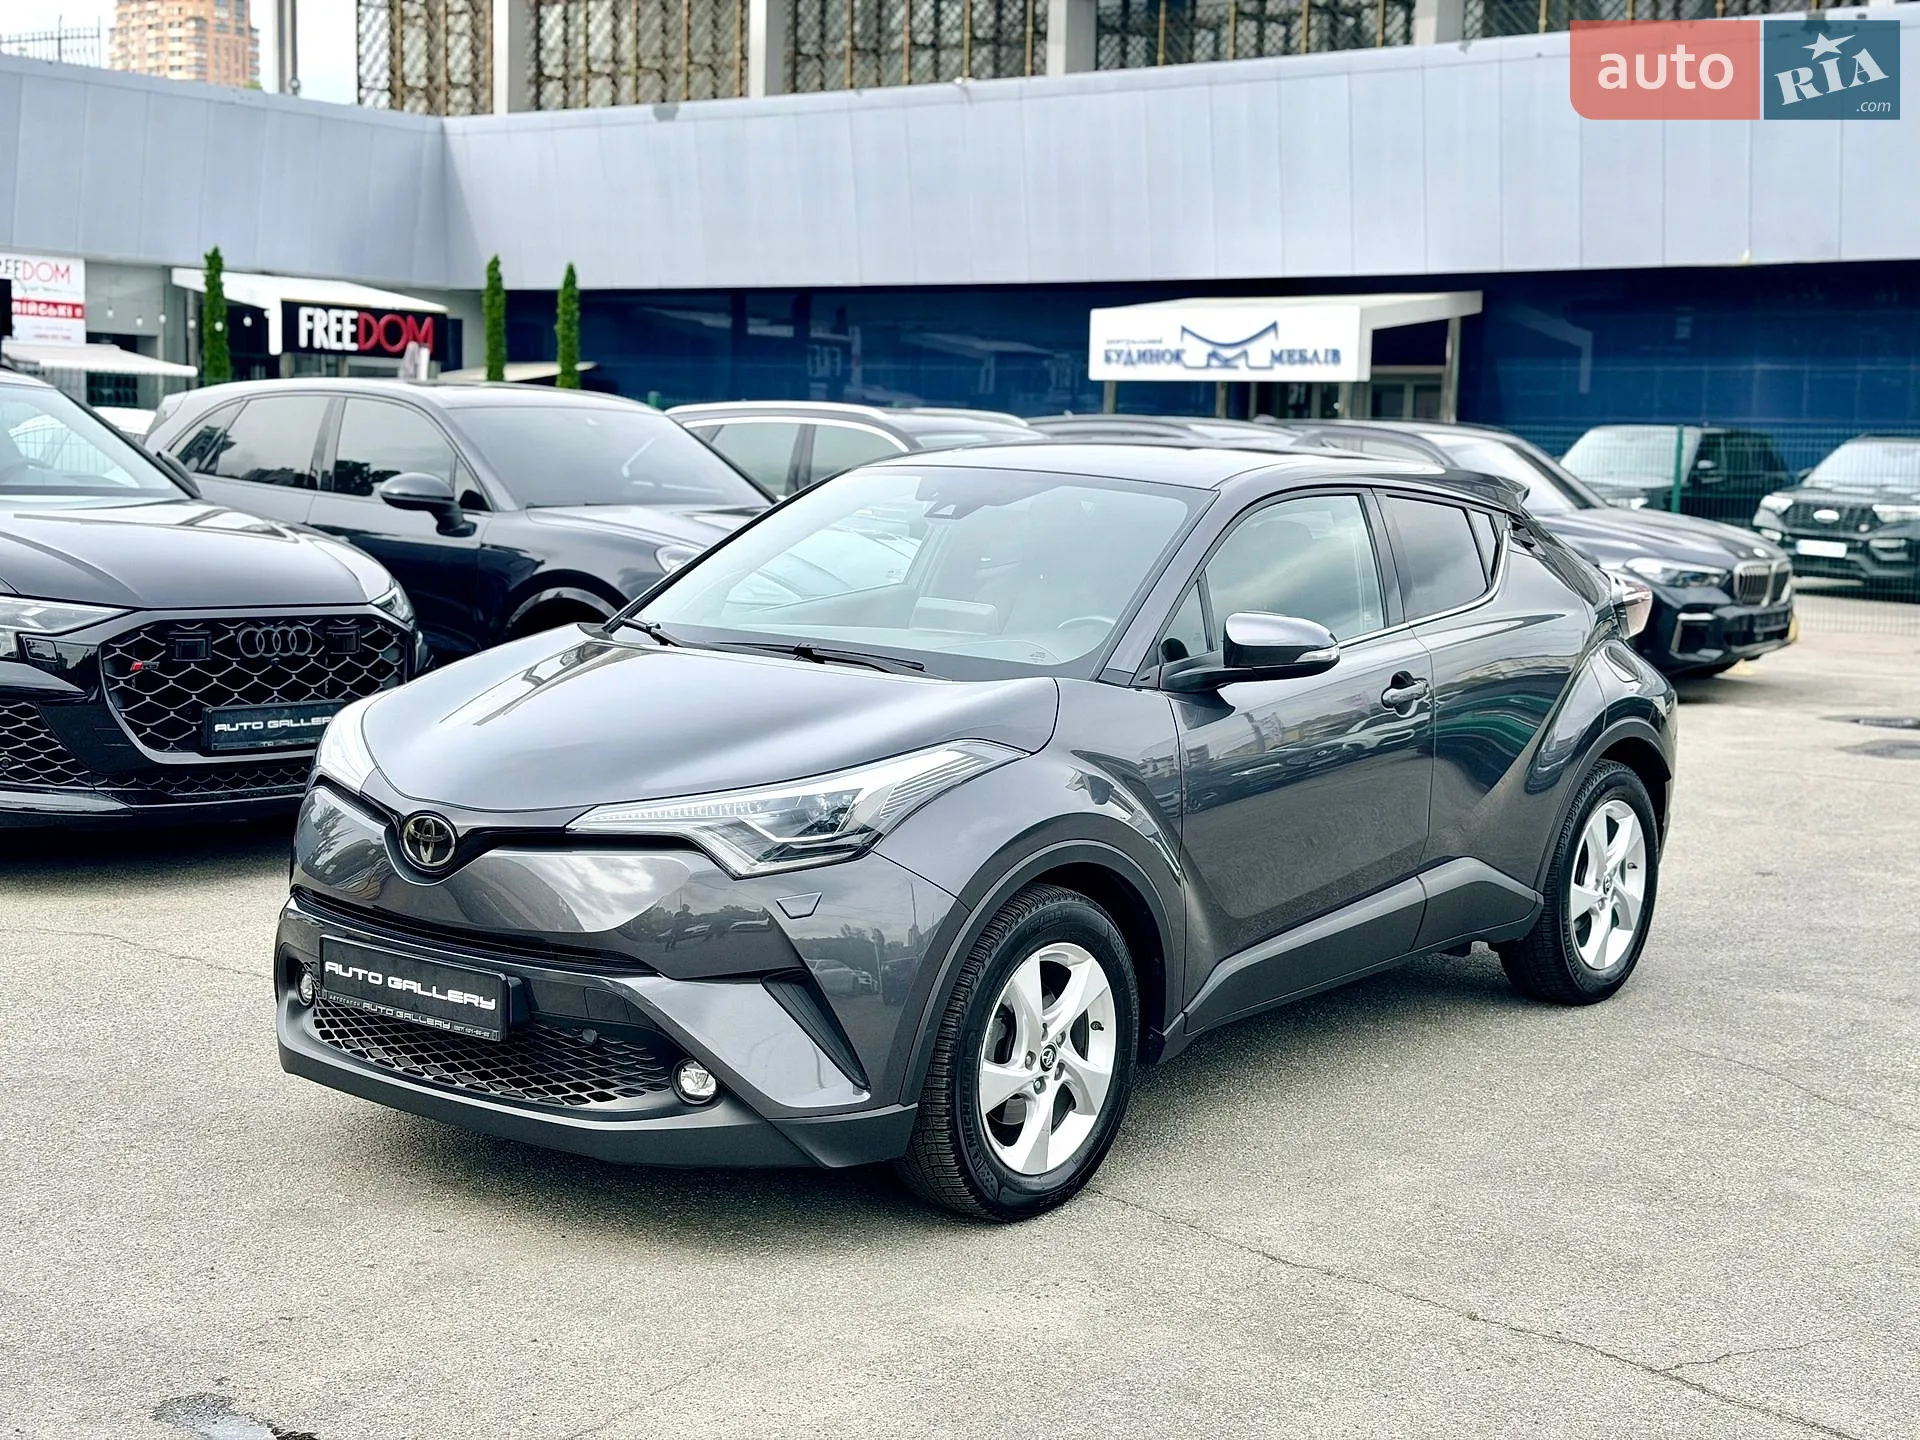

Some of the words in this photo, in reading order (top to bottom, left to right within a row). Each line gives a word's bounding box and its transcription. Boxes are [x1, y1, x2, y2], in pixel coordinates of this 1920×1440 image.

[0, 258, 72, 285] EEDOM
[298, 306, 434, 354] FREEDOM
[214, 721, 264, 733] AUTO
[267, 716, 333, 729] GALLER
[324, 961, 384, 985] AUTO
[387, 975, 497, 1011] GALLERY
[362, 1002, 394, 1016] AUTO
[396, 1010, 451, 1030] GALLERY
